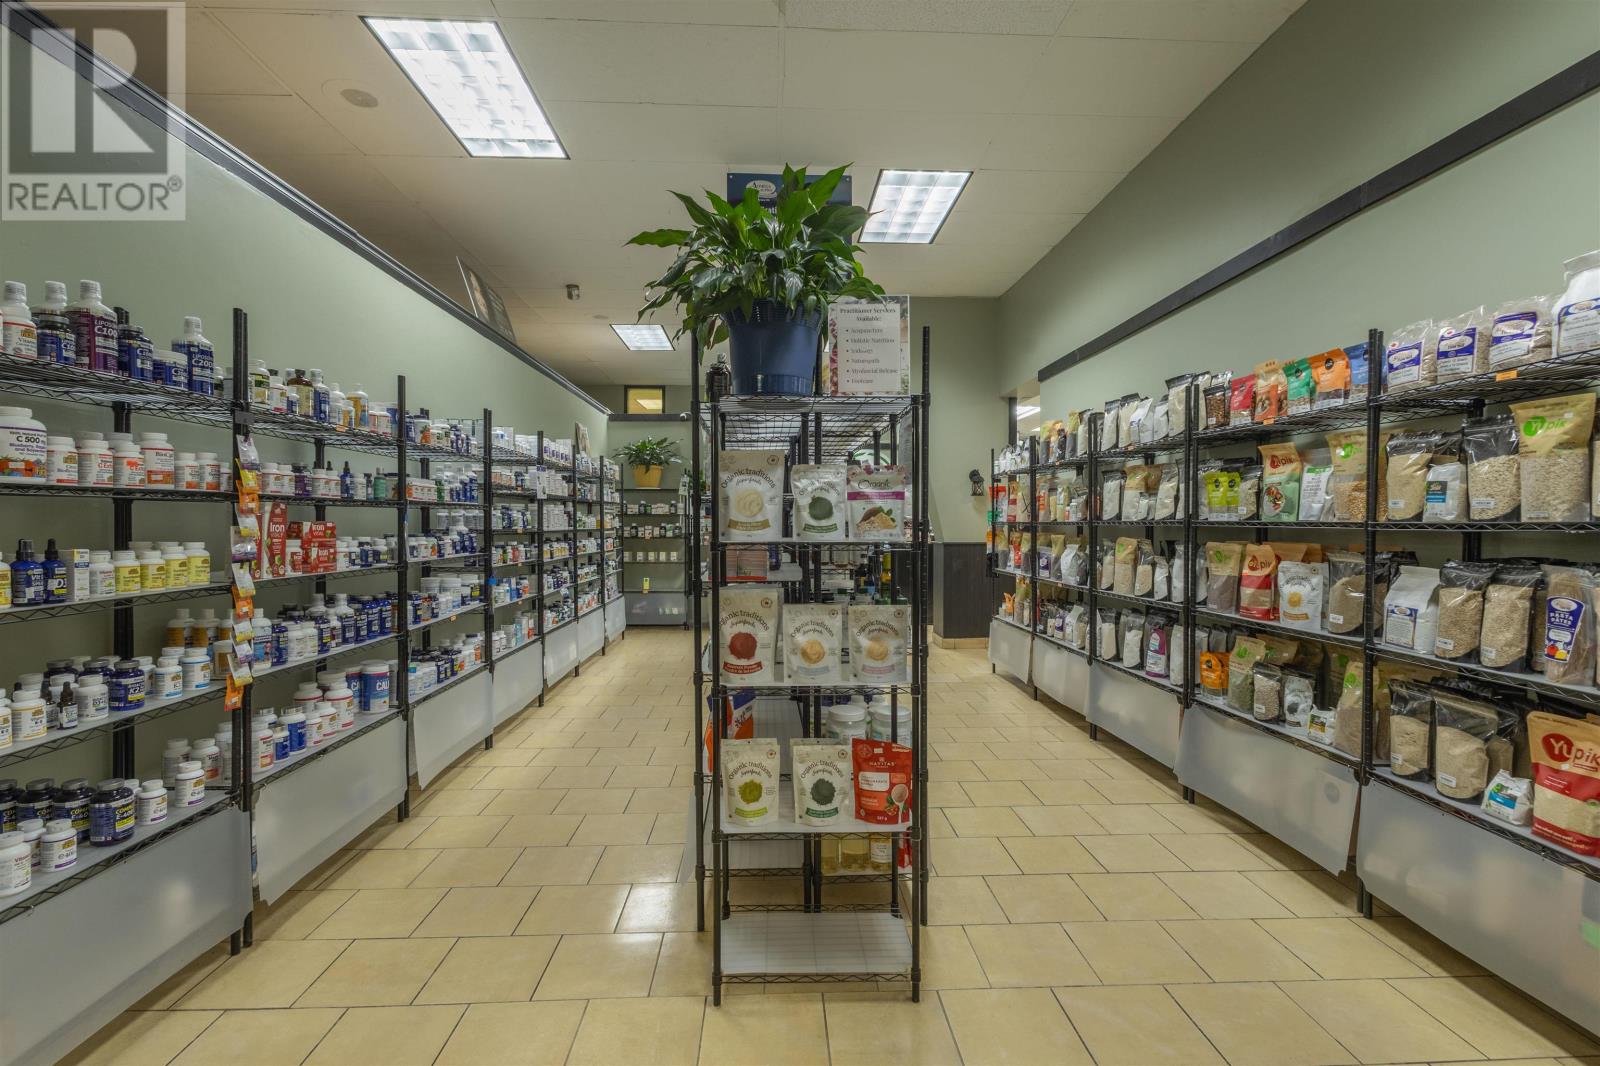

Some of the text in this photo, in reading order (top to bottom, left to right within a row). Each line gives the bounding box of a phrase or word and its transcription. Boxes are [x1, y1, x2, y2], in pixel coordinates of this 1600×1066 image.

[16, 435, 23, 443] C
[24, 436, 40, 444] 500
[270, 522, 285, 532] Iron
[1550, 612, 1573, 621] PASTA
[129, 686, 140, 695] K2
[1550, 737, 1600, 767] Yupik
